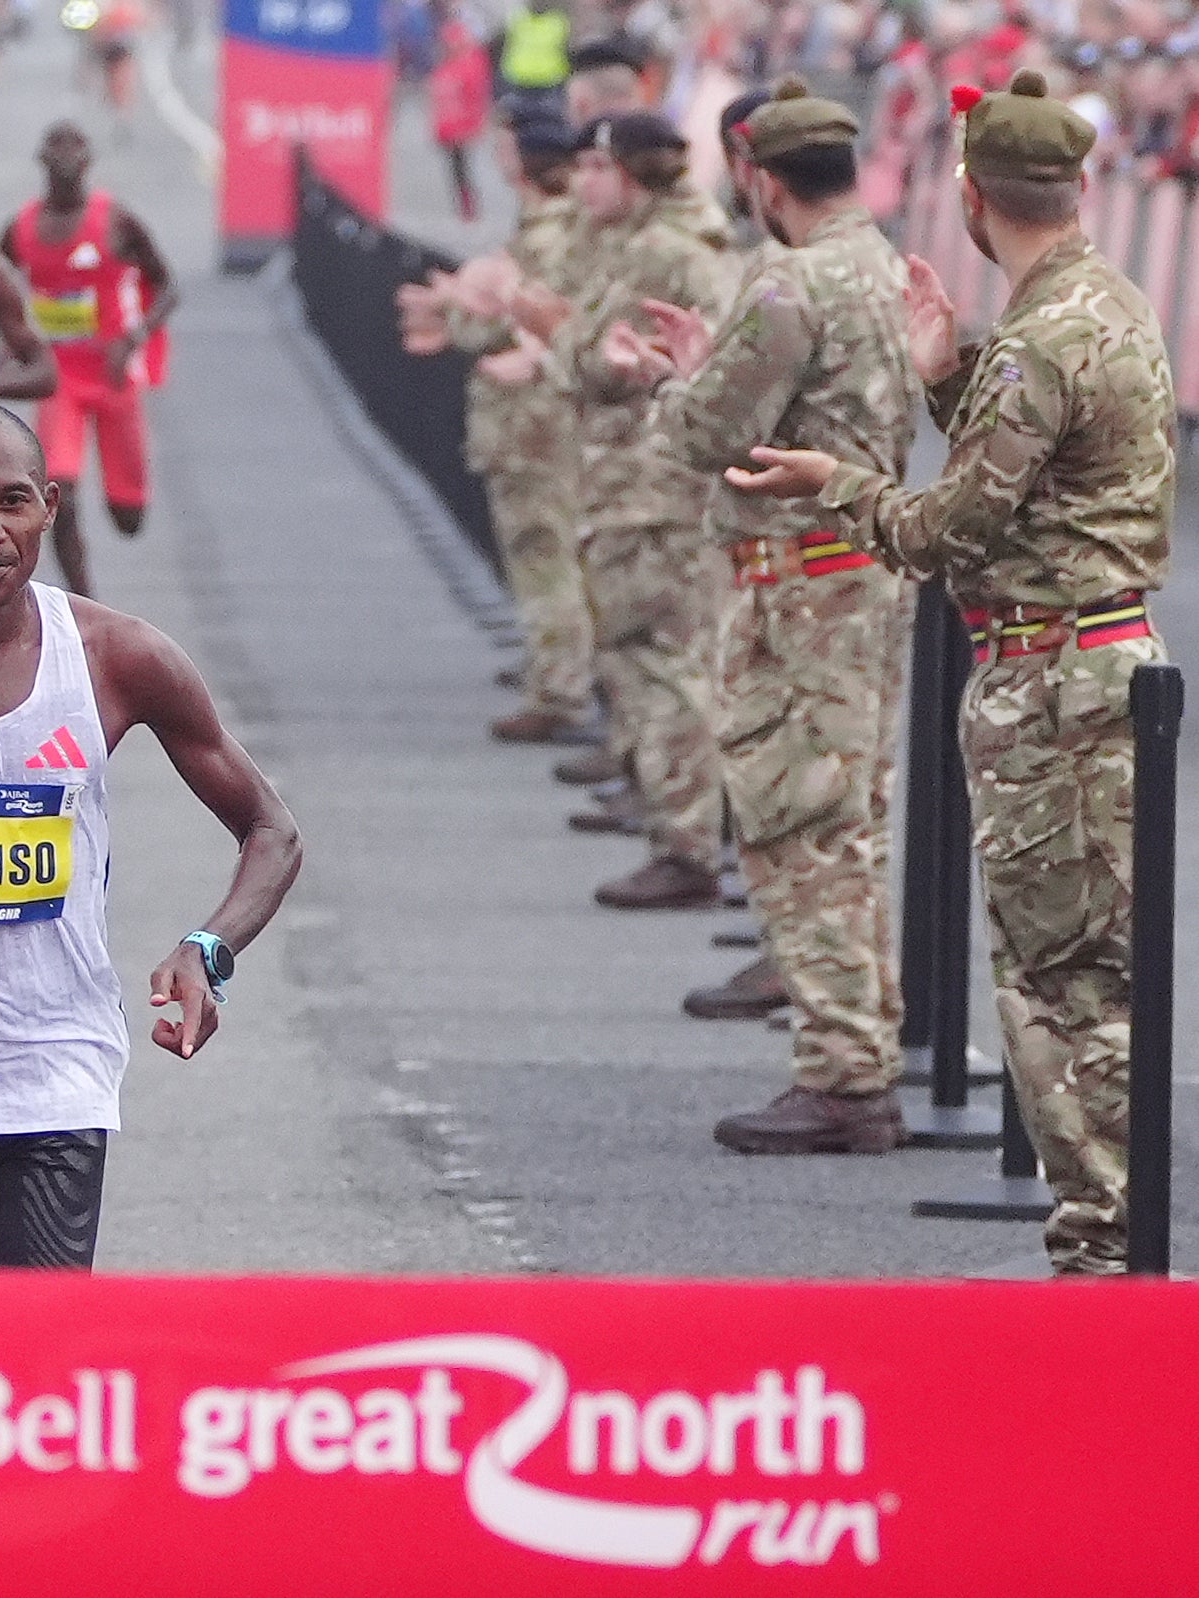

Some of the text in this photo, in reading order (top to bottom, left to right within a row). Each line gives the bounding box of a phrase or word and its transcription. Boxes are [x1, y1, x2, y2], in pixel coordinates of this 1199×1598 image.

[178, 1369, 463, 1498] great
[568, 1365, 865, 1477] north
[700, 1500, 879, 1566] run
